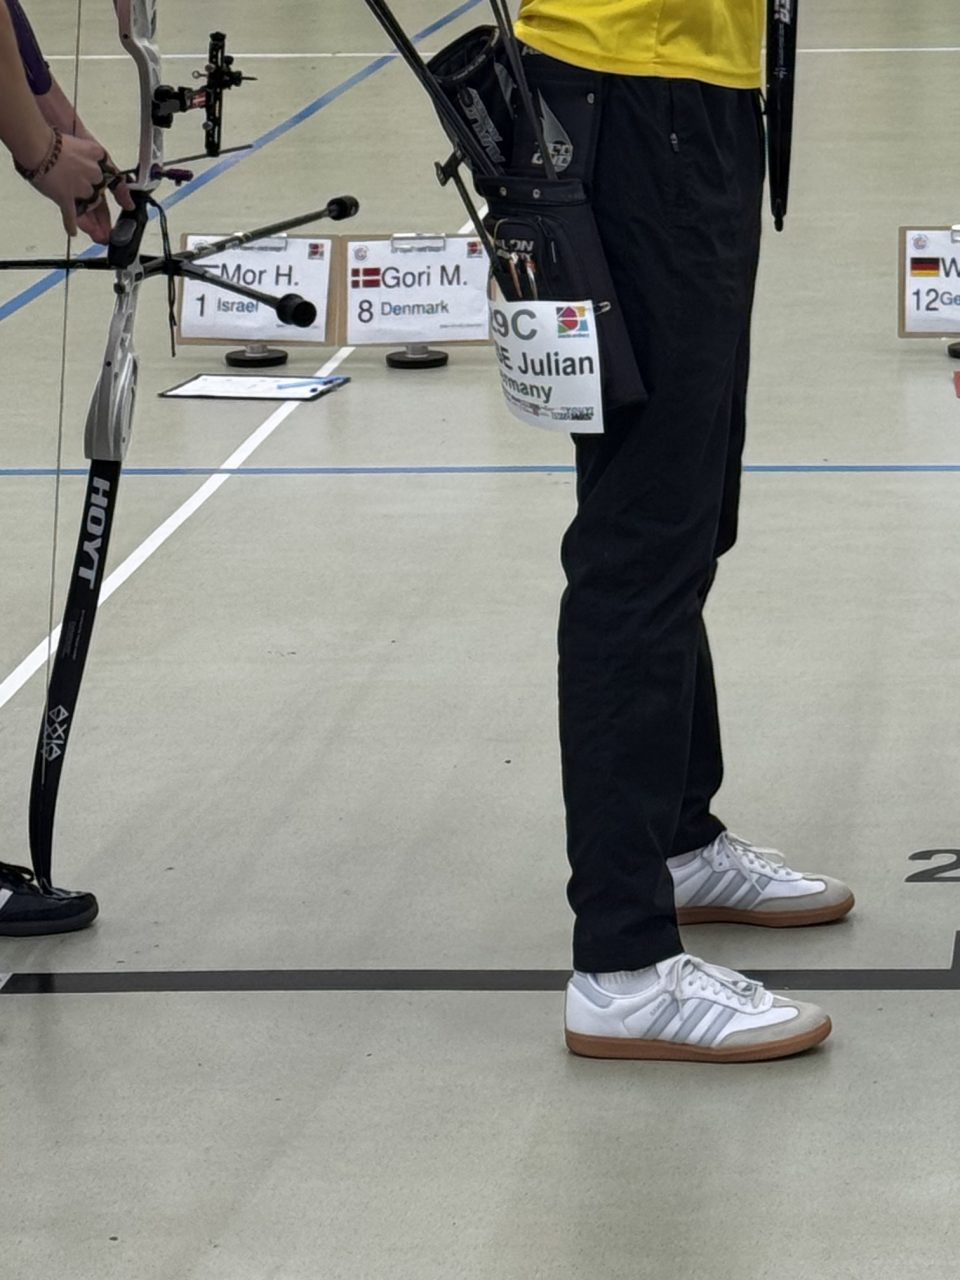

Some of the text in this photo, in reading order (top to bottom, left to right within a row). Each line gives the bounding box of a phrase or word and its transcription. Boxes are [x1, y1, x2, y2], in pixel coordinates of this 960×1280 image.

[275, 265, 299, 286] H.
[382, 264, 468, 289] Gori M.
[196, 294, 260, 317] 1 Israel
[357, 300, 449, 323] 8 Denmark
[912, 289, 939, 311] 12
[518, 351, 594, 376] Julian
[78, 475, 110, 589] HOYT
